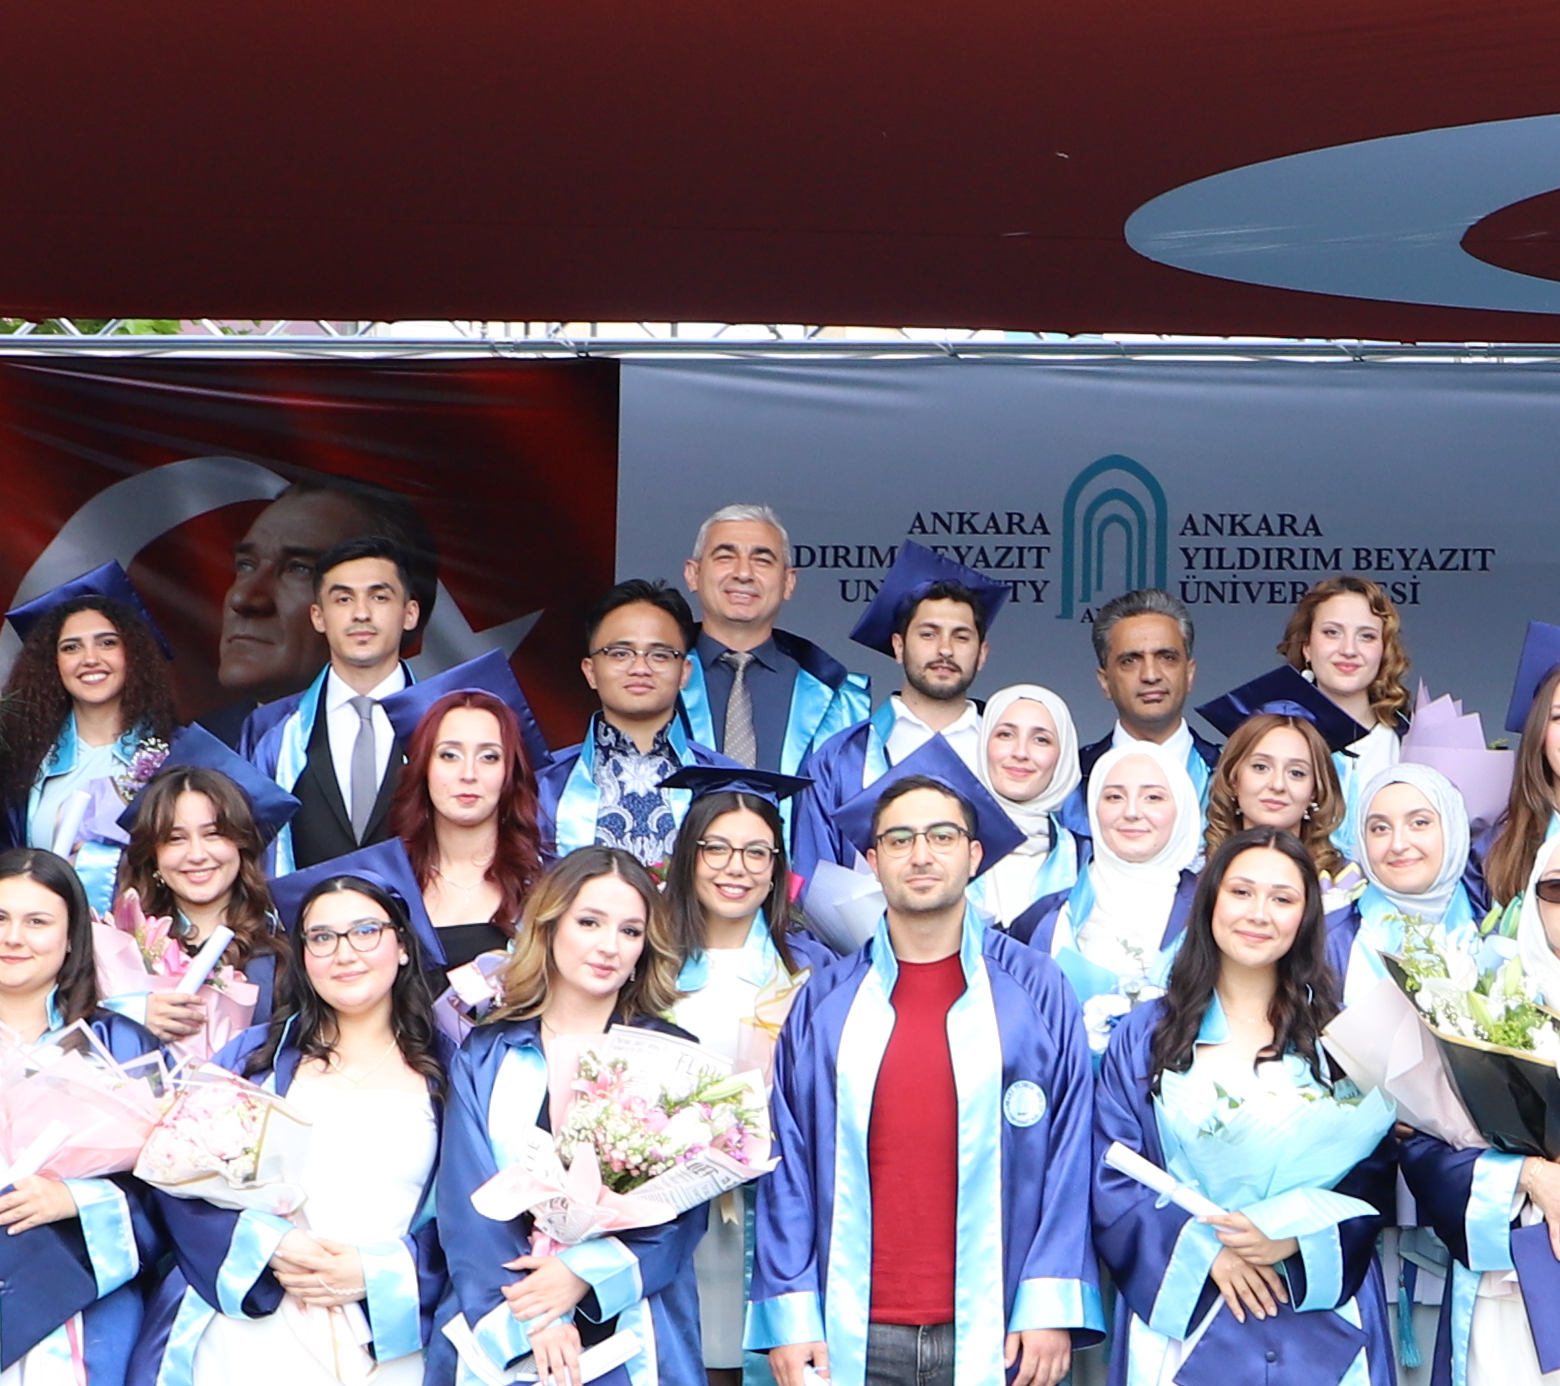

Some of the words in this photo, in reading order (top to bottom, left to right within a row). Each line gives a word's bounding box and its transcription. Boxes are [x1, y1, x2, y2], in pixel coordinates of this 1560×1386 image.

[906, 511, 1051, 536] ANKARA
[1178, 512, 1323, 537] ANKARA
[1178, 546, 1343, 571] YILDIRIM
[1352, 546, 1496, 572] BEYAZIT
